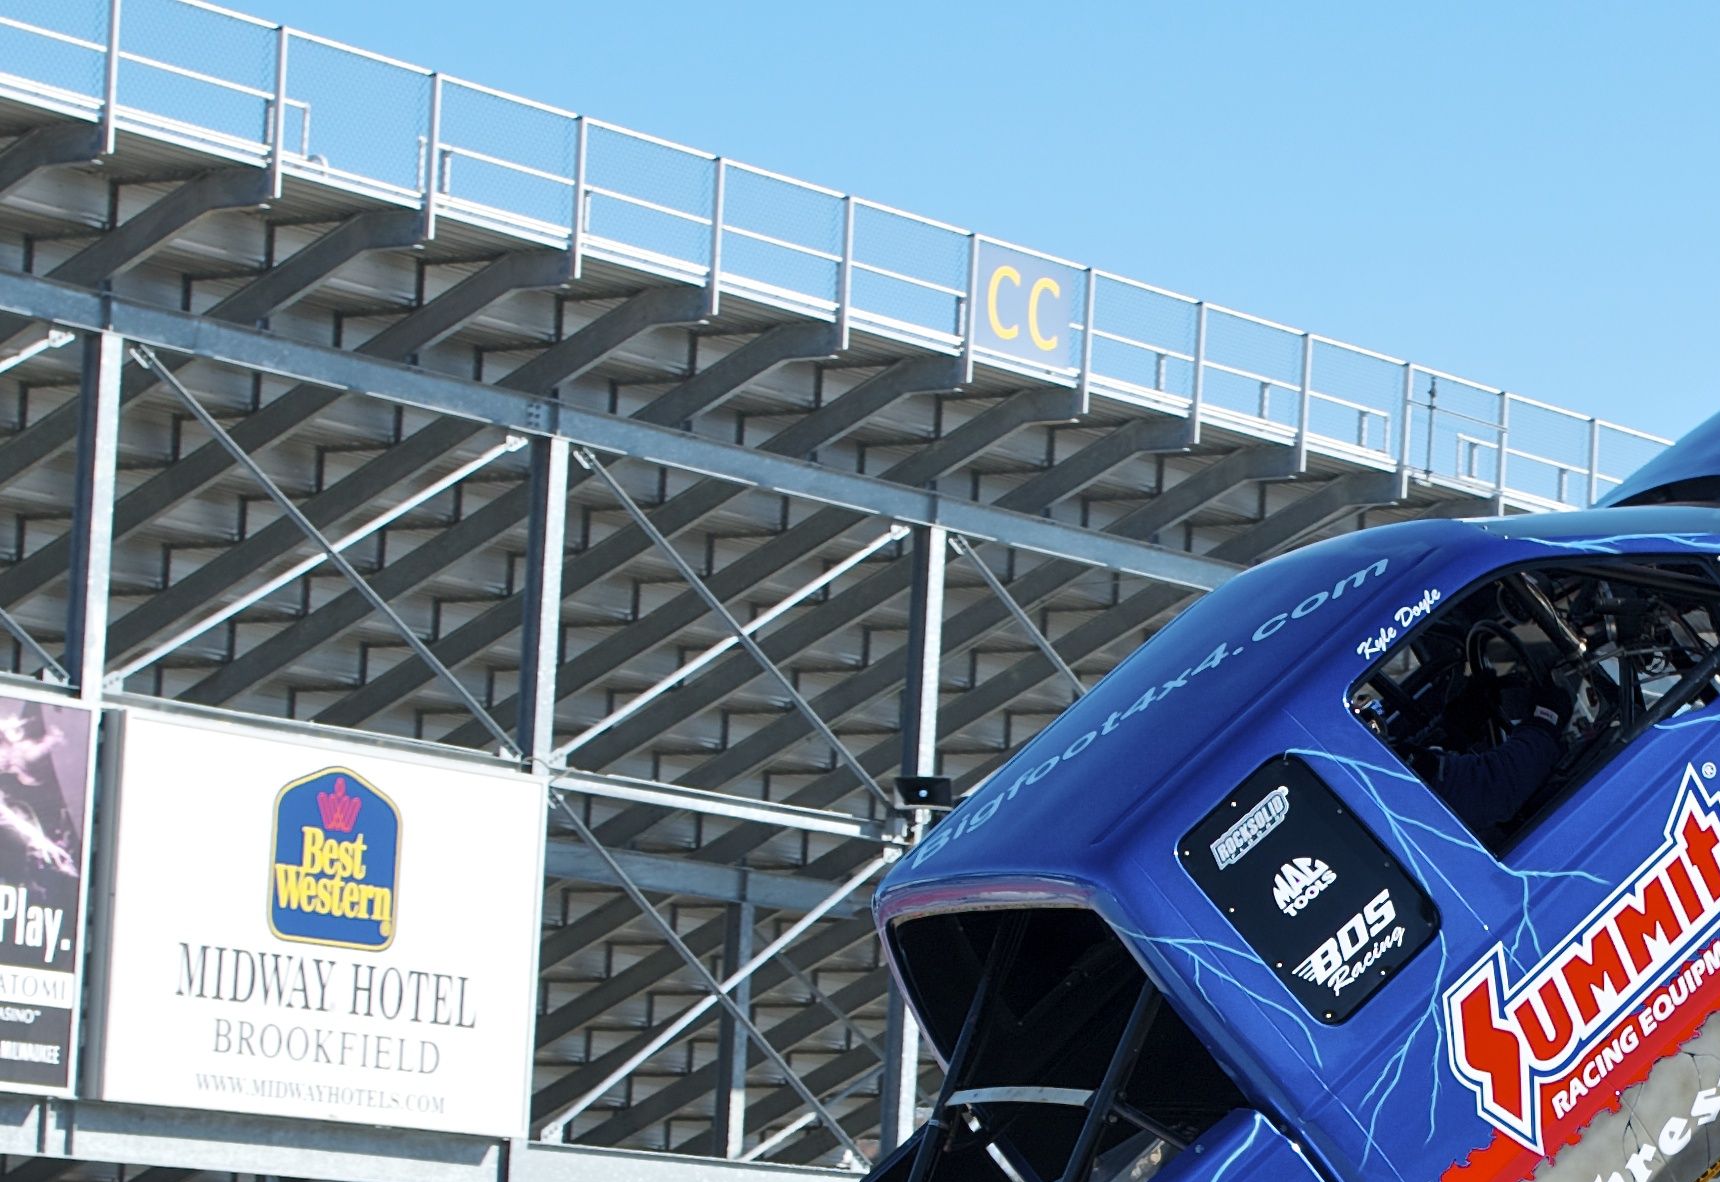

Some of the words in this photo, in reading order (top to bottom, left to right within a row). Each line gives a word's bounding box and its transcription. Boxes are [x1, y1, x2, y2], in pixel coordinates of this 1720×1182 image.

[988, 265, 1060, 351] CC
[1357, 627, 1397, 660] Kyle
[1394, 589, 1441, 628] Doyle
[911, 557, 1389, 870] Bigfoot4x4.com
[302, 827, 367, 880] Best
[1272, 857, 1330, 909] MAC
[275, 863, 392, 923] Western
[1284, 870, 1337, 917] TOOLS
[175, 942, 337, 1012] MIDWAY
[348, 963, 476, 1029] HOTEL
[1328, 926, 1406, 997] Racing
[212, 1018, 440, 1075] BROOKFIELD
[1551, 1031, 1639, 1119] RACING
